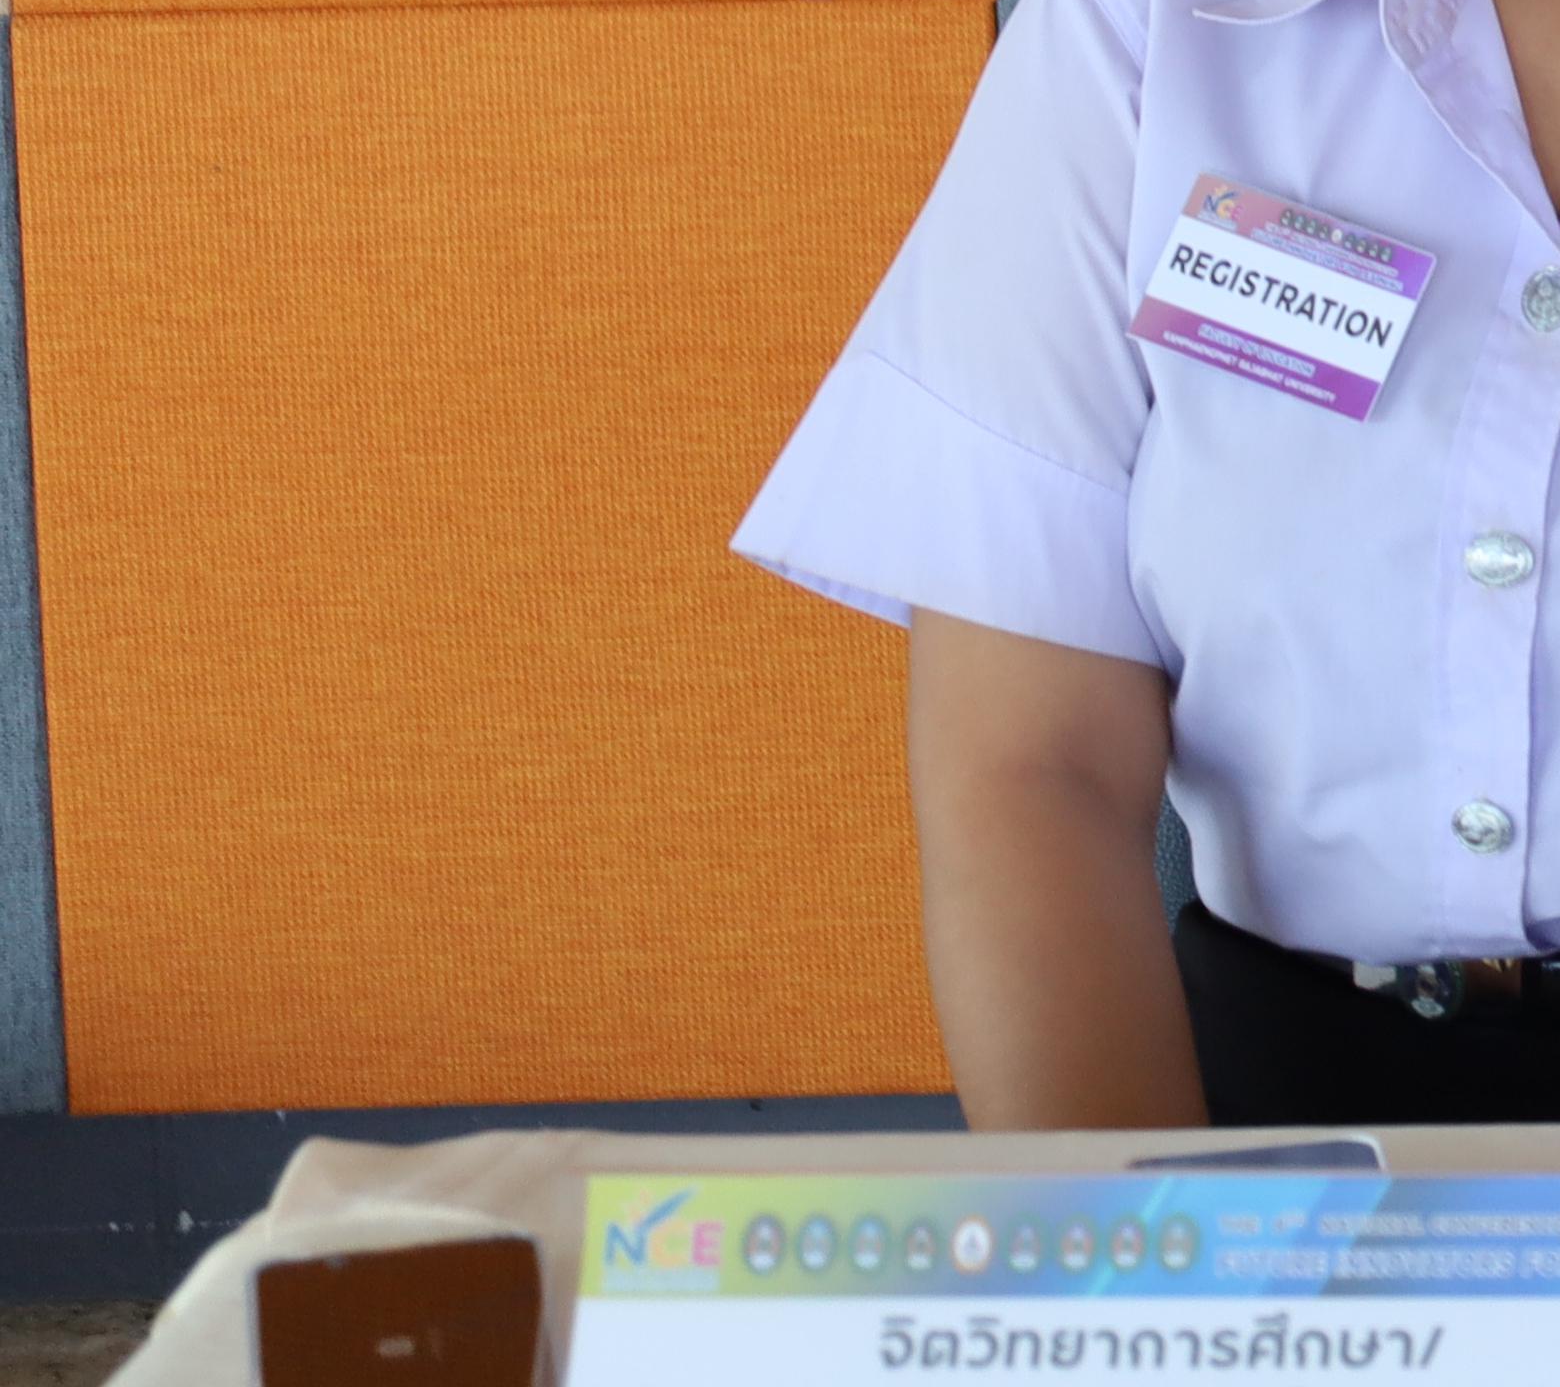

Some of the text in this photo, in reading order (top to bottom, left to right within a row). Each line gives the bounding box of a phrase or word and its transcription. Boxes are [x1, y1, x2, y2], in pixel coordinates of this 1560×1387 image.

[1170, 244, 1393, 348] REGISTRATION
[604, 1220, 725, 1269] NCE
[880, 1313, 1443, 1371] จิตวิทยาการศึกษา/
